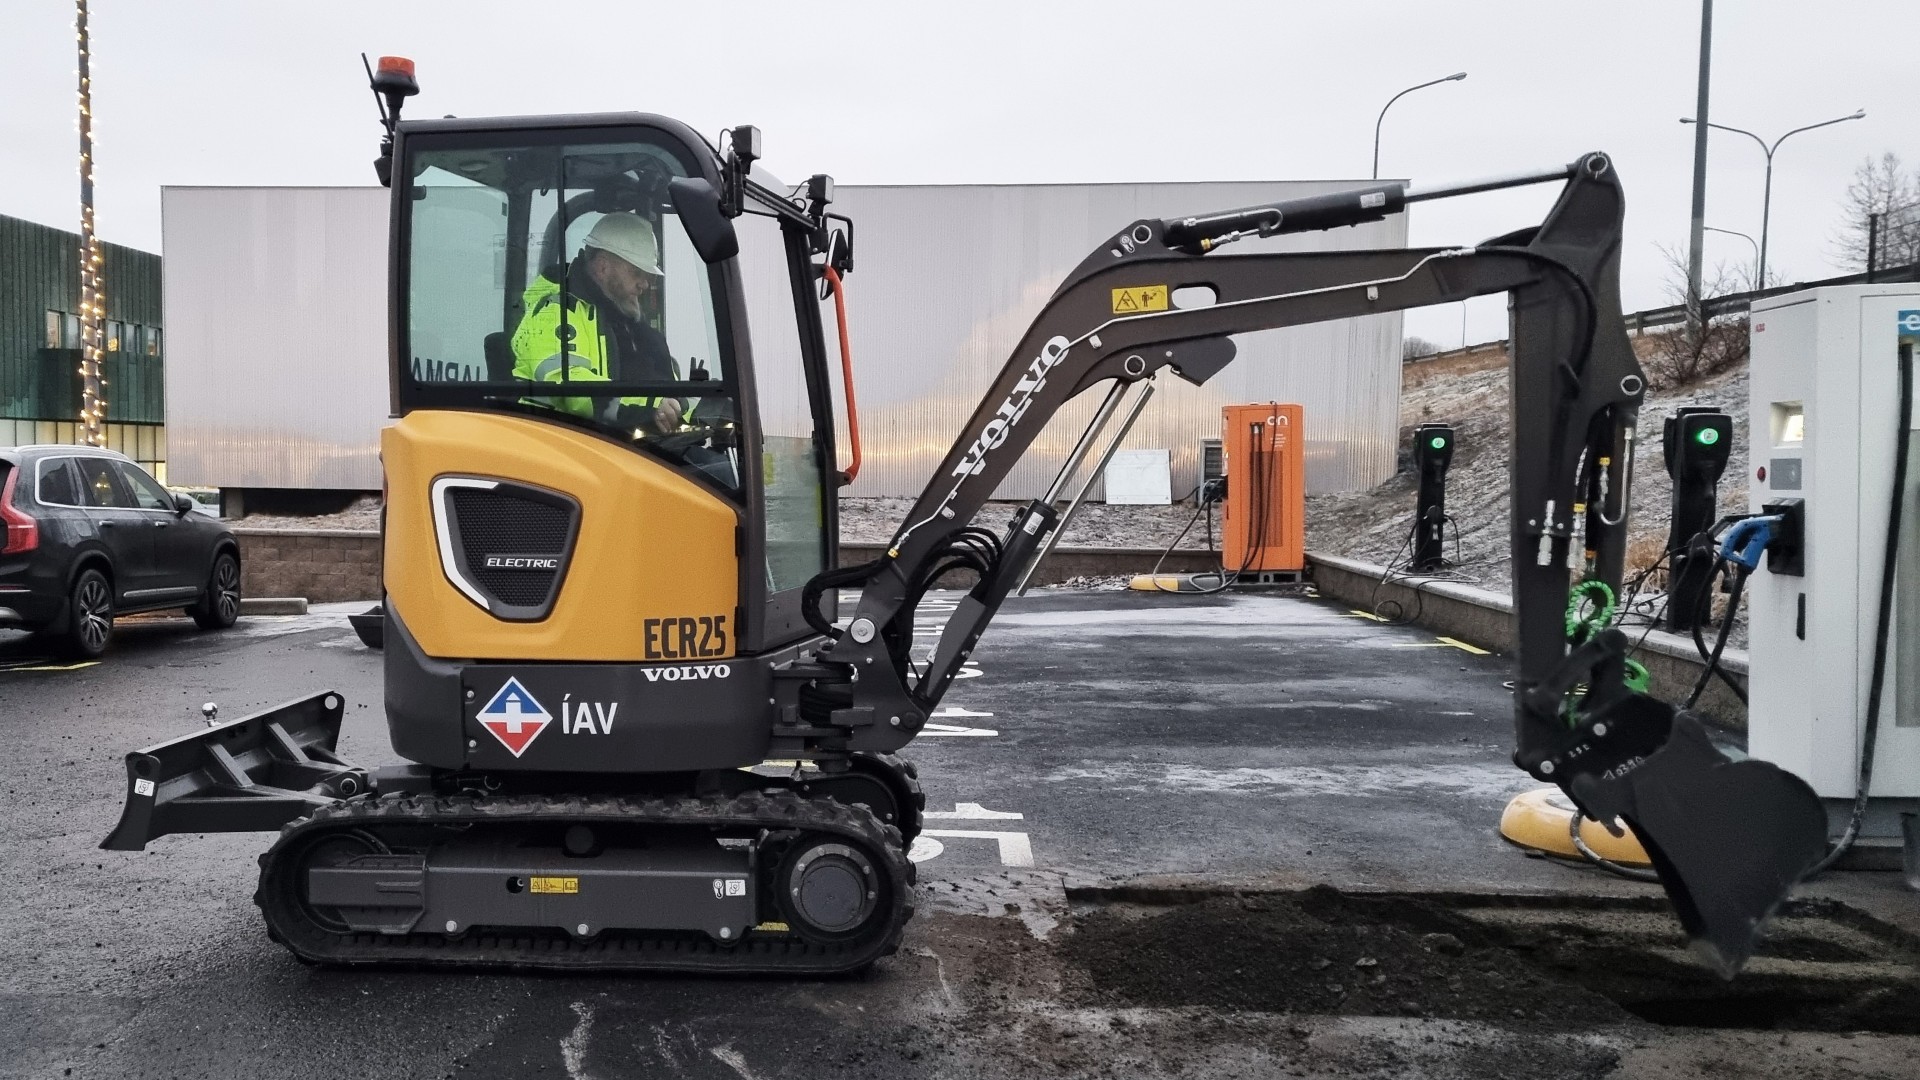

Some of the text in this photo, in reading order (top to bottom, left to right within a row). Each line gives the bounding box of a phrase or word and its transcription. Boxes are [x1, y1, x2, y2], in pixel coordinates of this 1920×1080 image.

[951, 335, 1070, 477] VOLVO
[486, 557, 558, 568] ELECTRIC
[643, 615, 727, 660] ECR25
[640, 664, 731, 682] VOLVO
[562, 693, 618, 735] ÍAV
